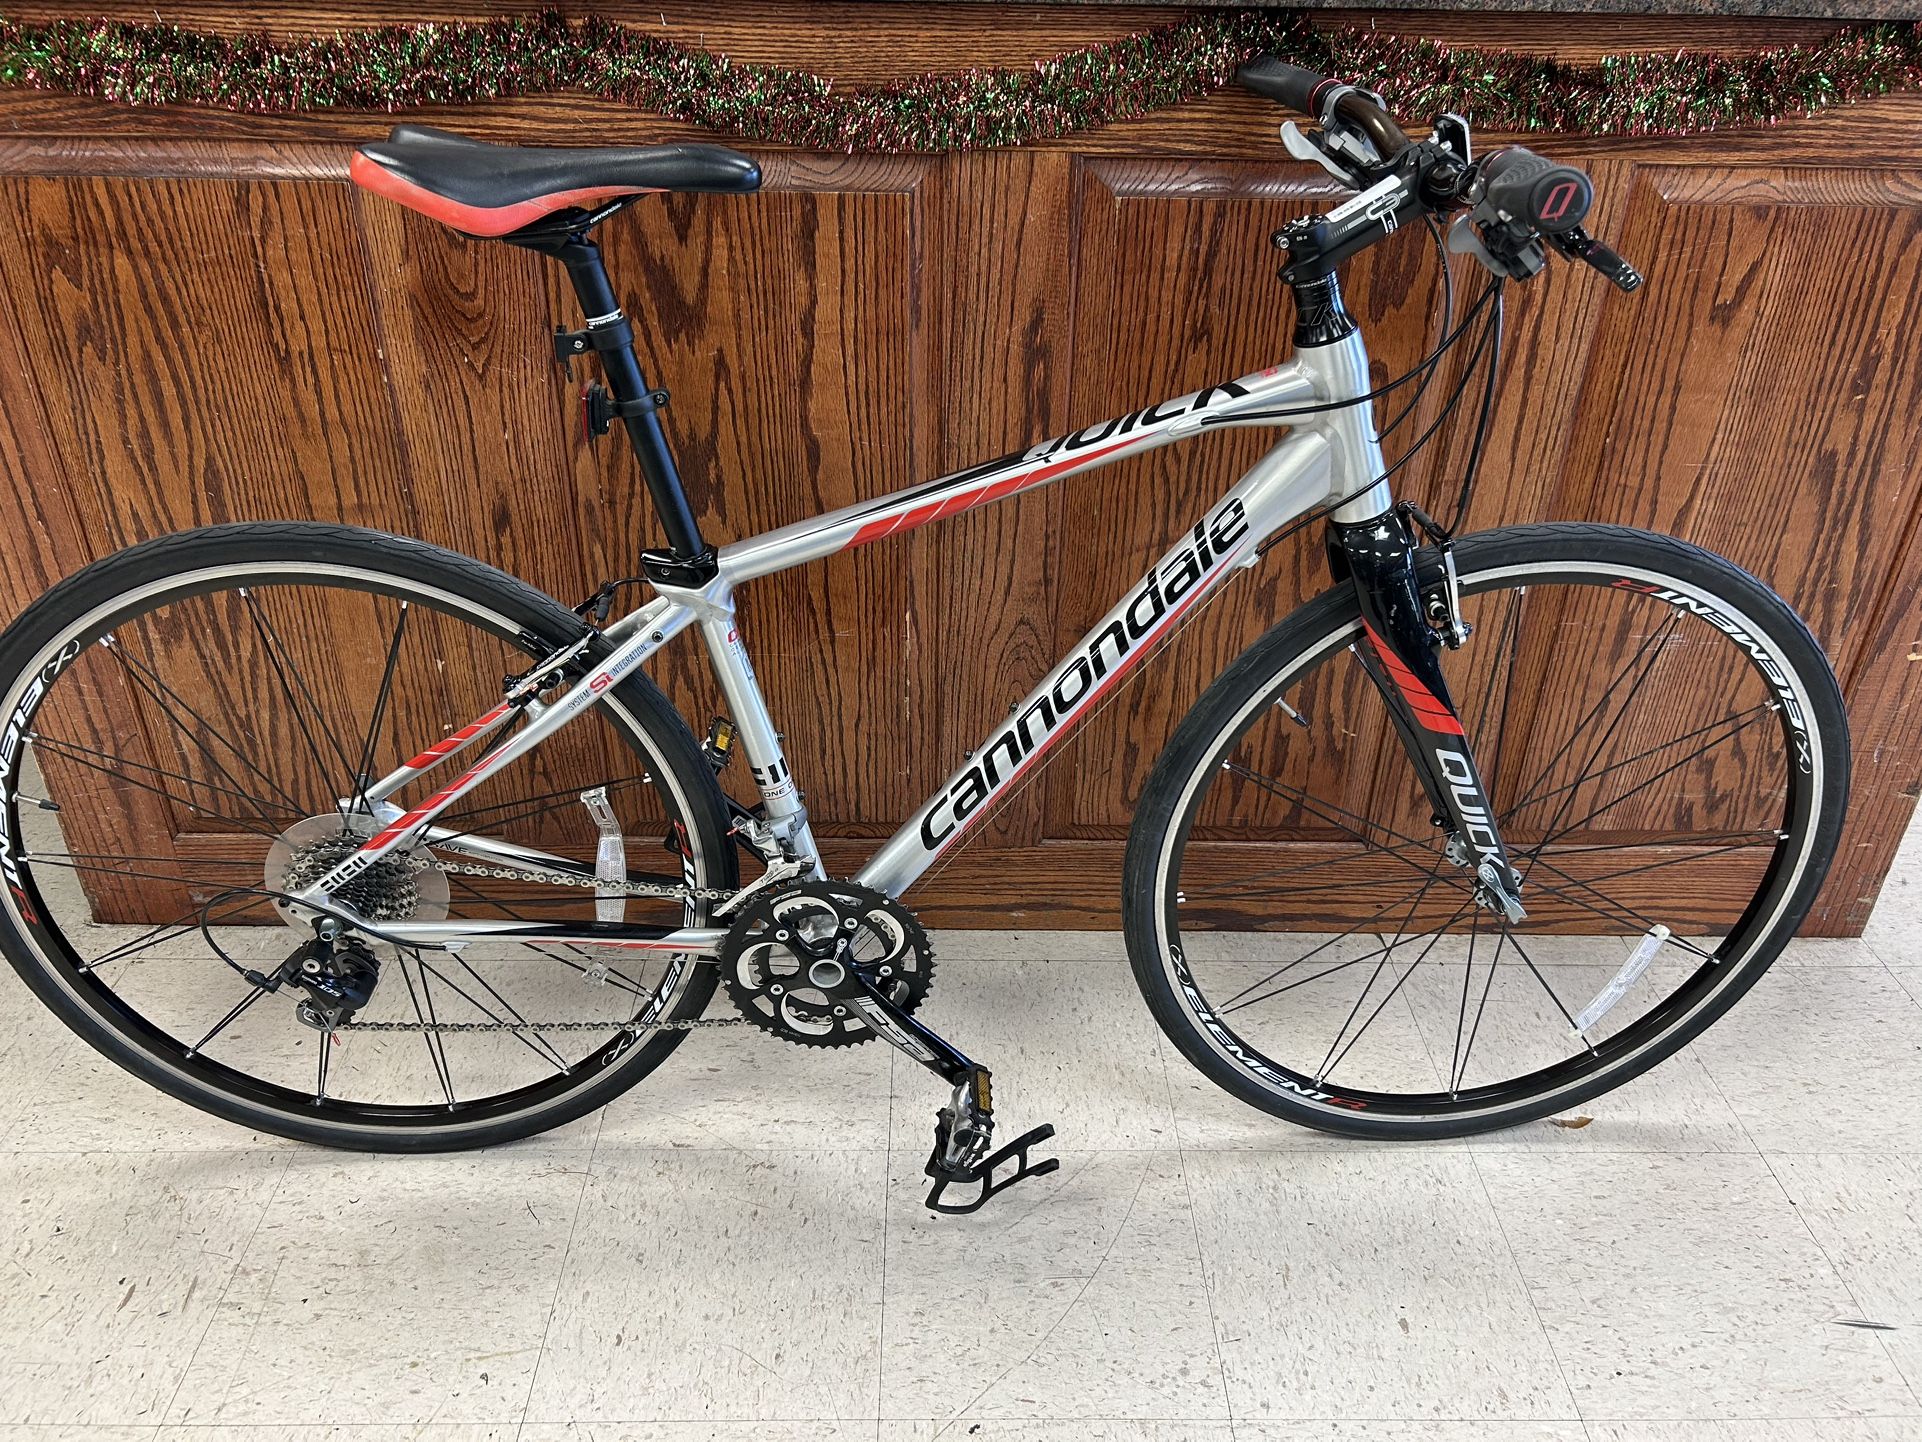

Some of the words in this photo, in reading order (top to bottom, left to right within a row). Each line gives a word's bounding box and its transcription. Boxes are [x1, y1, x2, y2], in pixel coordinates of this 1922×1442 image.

[567, 689, 592, 712] SYSTEM
[589, 671, 614, 695] Si
[611, 642, 648, 678] INTEGRATION
[920, 498, 1249, 850] cannondale
[1650, 590, 1806, 731] ELEMENT
[763, 787, 786, 798] ONE
[1182, 985, 1335, 1101] ELEMENT
